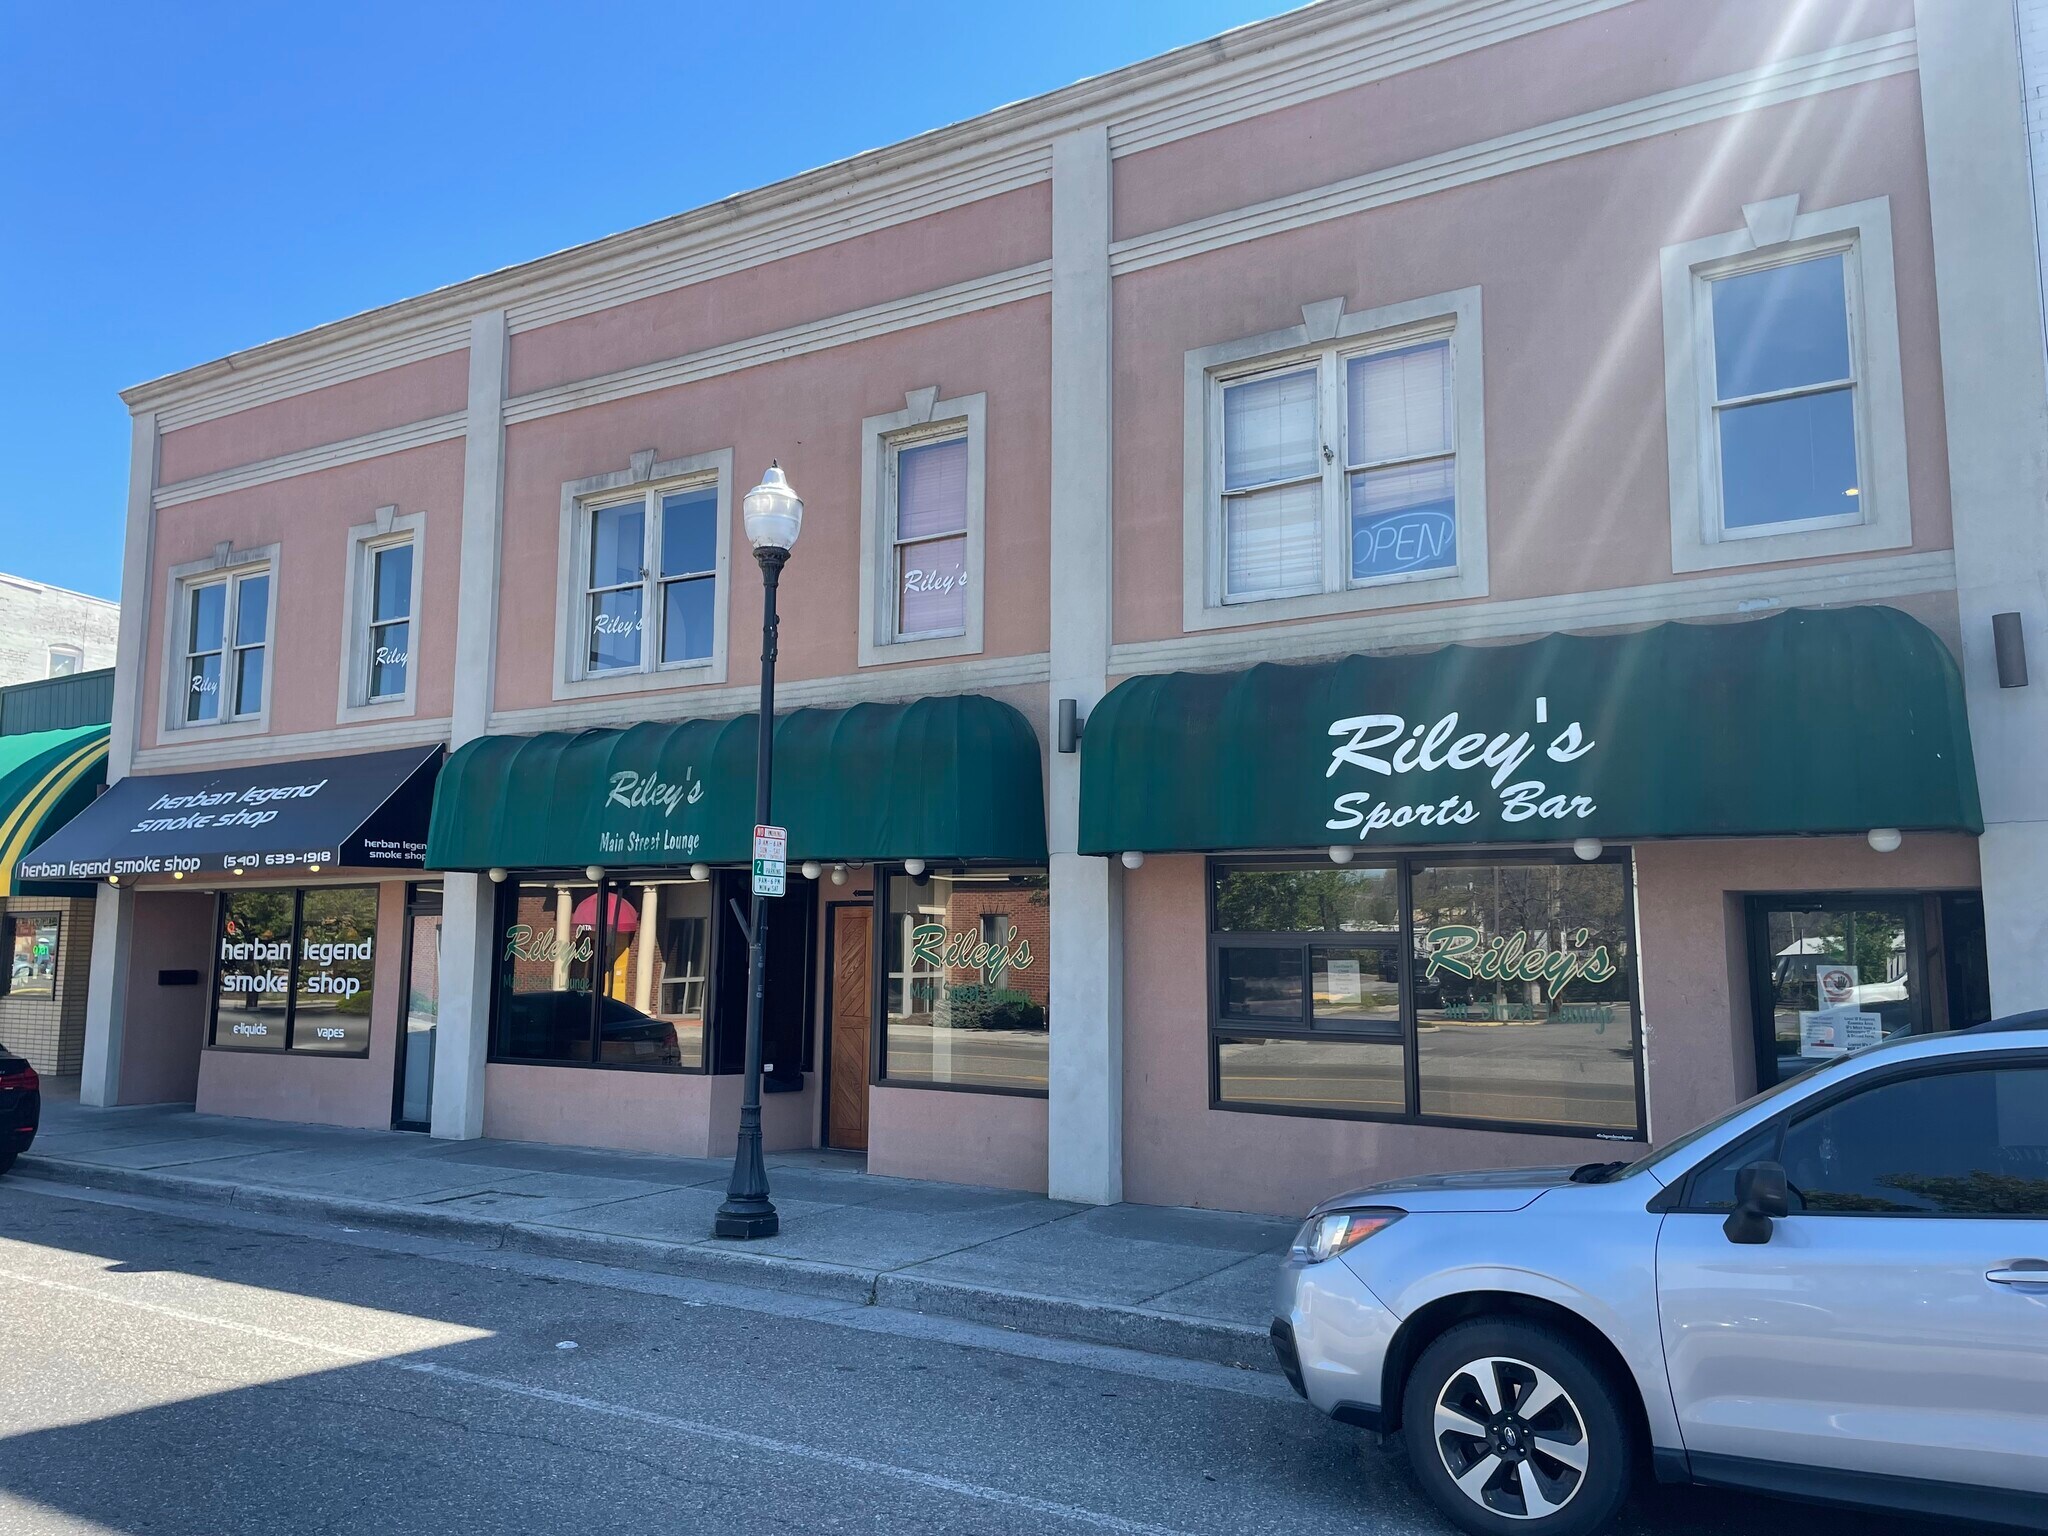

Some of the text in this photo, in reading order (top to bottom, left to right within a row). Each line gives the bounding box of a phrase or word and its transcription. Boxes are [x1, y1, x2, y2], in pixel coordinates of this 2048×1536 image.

[1352, 521, 1446, 565] OPEN
[904, 563, 968, 595] Riley's
[375, 646, 408, 668] Riley
[1325, 696, 1596, 790] Riley's
[148, 779, 329, 811] herban legend
[605, 766, 704, 817] Riley's
[130, 809, 279, 832] smoke shop
[1325, 780, 1597, 840] Sports Bar
[364, 838, 427, 851] herban legen
[369, 850, 426, 861] smoke shop
[600, 829, 700, 855] Main Street Lounge
[21, 855, 201, 878] herban legend smoke shop
[223, 851, 331, 869] (540) 639-1918
[756, 860, 762, 874] 2
[221, 936, 372, 967] herban legend
[504, 924, 594, 973] Riley's
[910, 923, 1034, 983] Riley's
[1425, 924, 1617, 1000] Riley's
[223, 970, 360, 1000] smoke shop
[233, 1022, 345, 1040] e-liquids vapes
